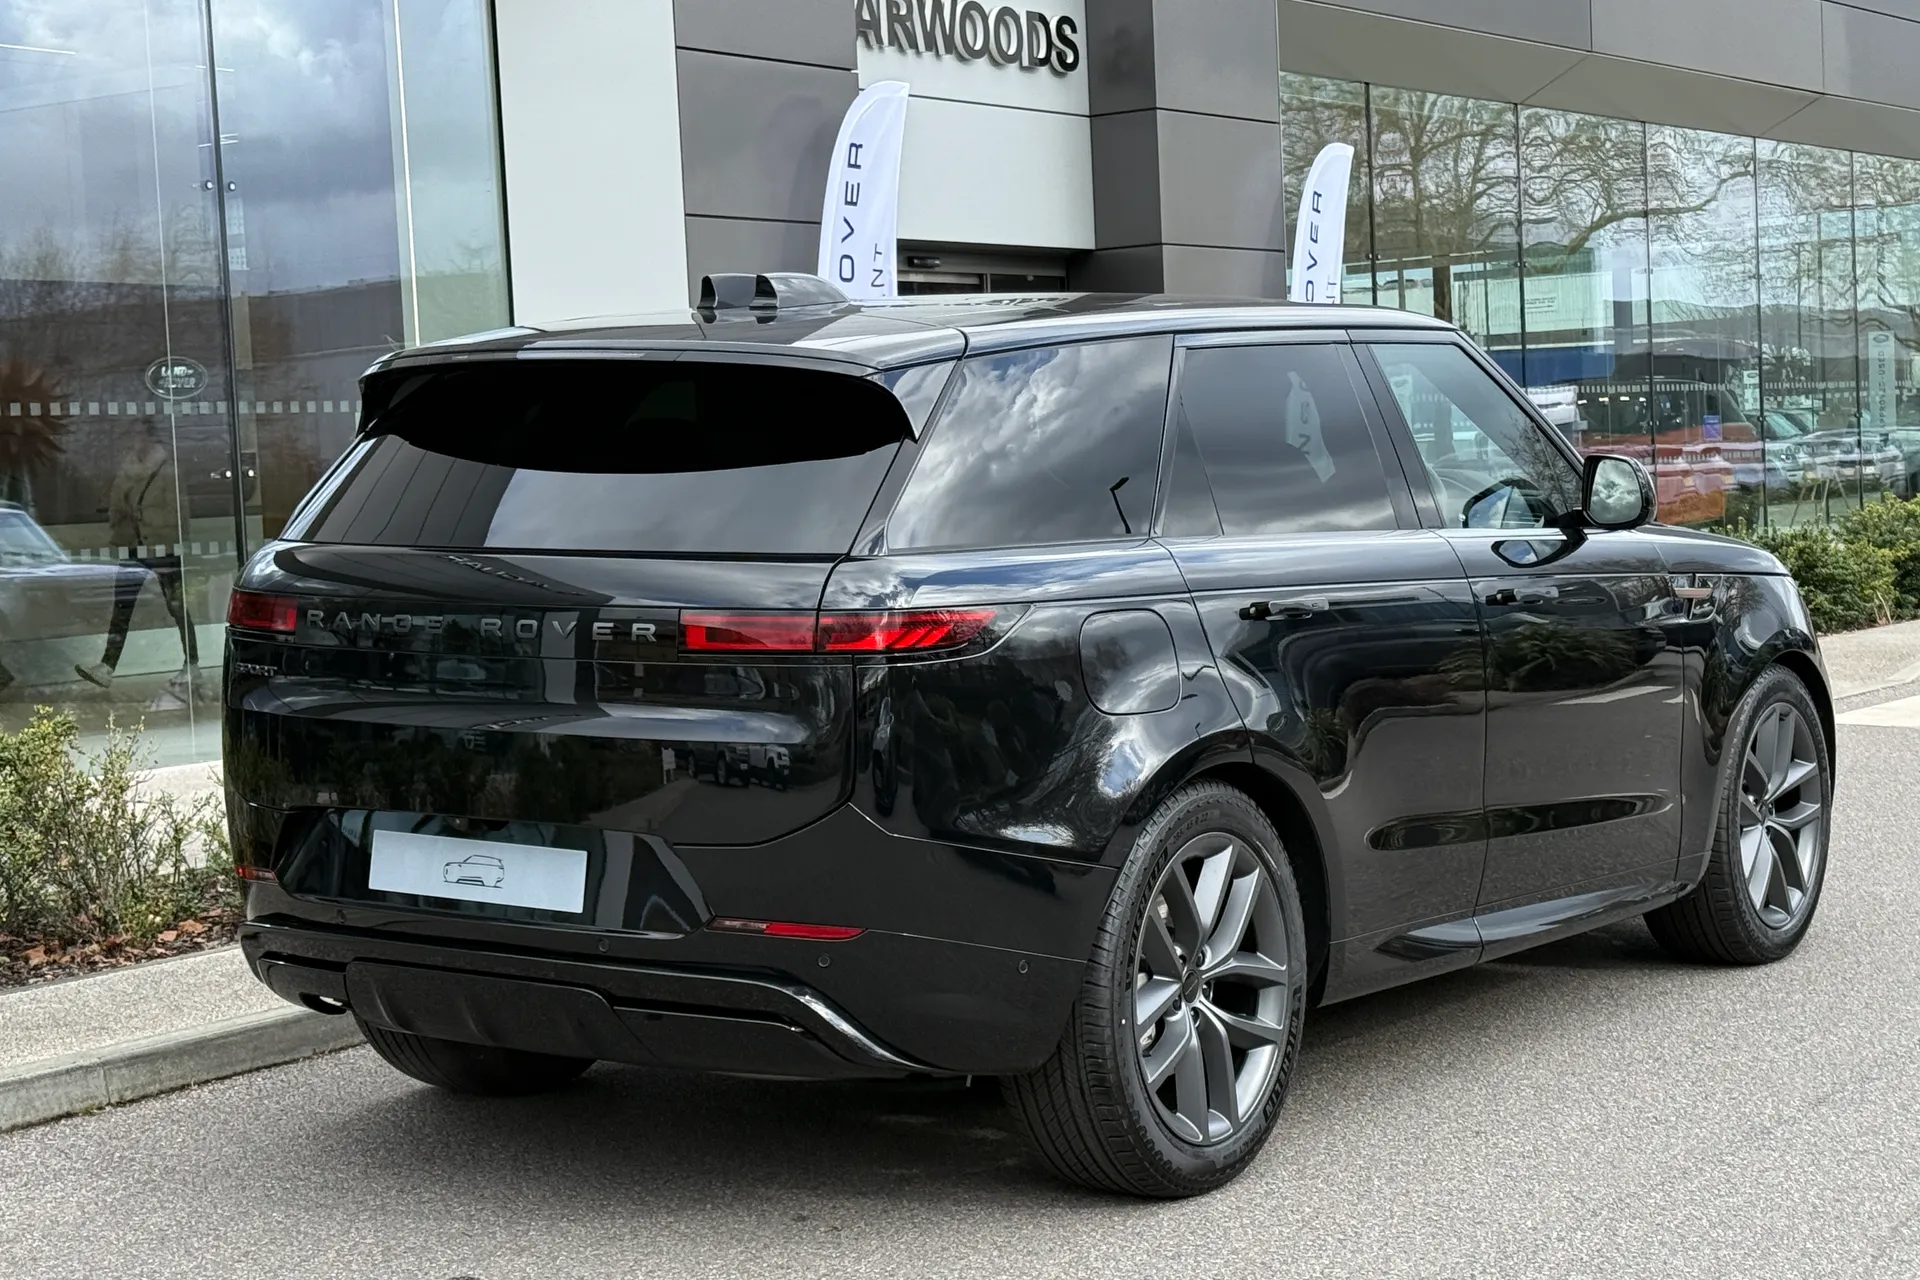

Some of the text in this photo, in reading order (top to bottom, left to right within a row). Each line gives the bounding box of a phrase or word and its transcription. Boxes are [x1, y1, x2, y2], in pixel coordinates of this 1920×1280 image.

[839, 142, 863, 283] OVER
[871, 243, 885, 296] NT
[307, 609, 656, 642] RANGE ROVER
[236, 662, 278, 676] SPORT
[1265, 1015, 1299, 1118] MICHELIN
